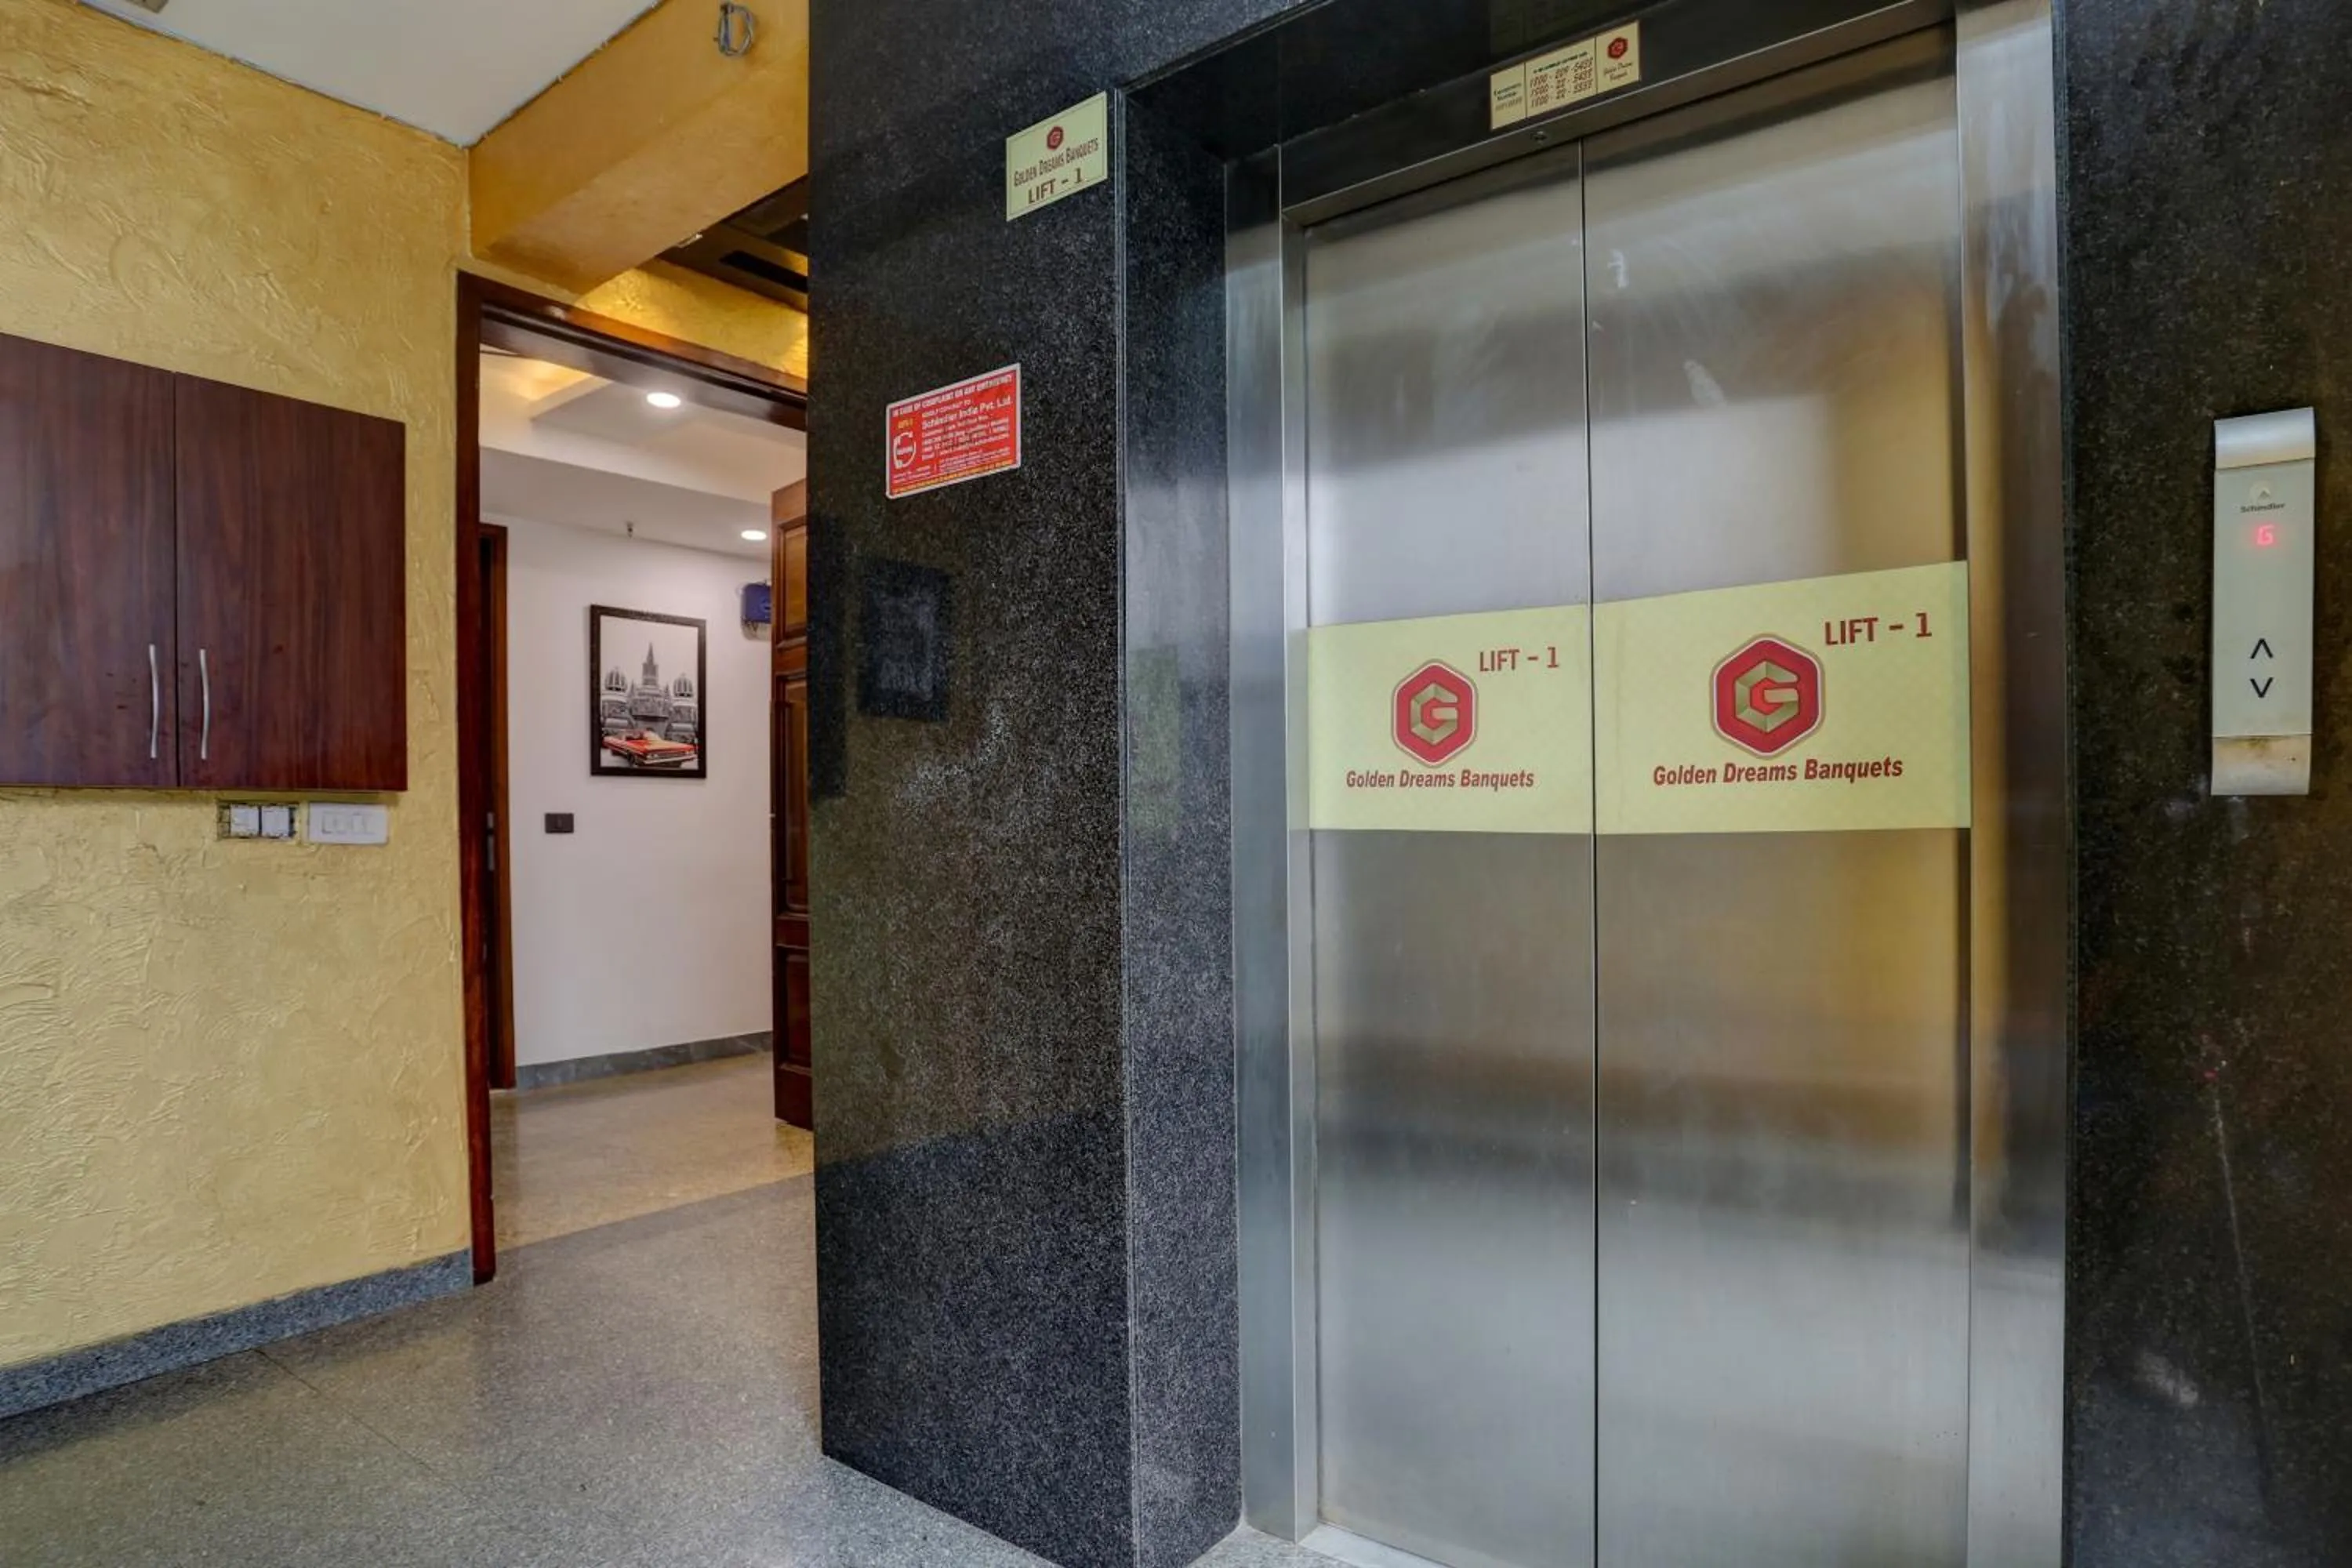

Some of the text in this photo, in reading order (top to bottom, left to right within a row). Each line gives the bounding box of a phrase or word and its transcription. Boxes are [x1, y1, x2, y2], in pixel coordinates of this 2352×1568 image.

[1028, 178, 1056, 204] LIFT
[1074, 167, 1083, 184] 1
[1824, 617, 1878, 645] LIFT
[1915, 612, 1933, 638] 1
[1479, 648, 1520, 672] LIFT
[1547, 646, 1559, 669] 1
[1346, 768, 1535, 792] Golden Dreams Banquets
[1653, 756, 1904, 786] Golden Dreams Banquets
